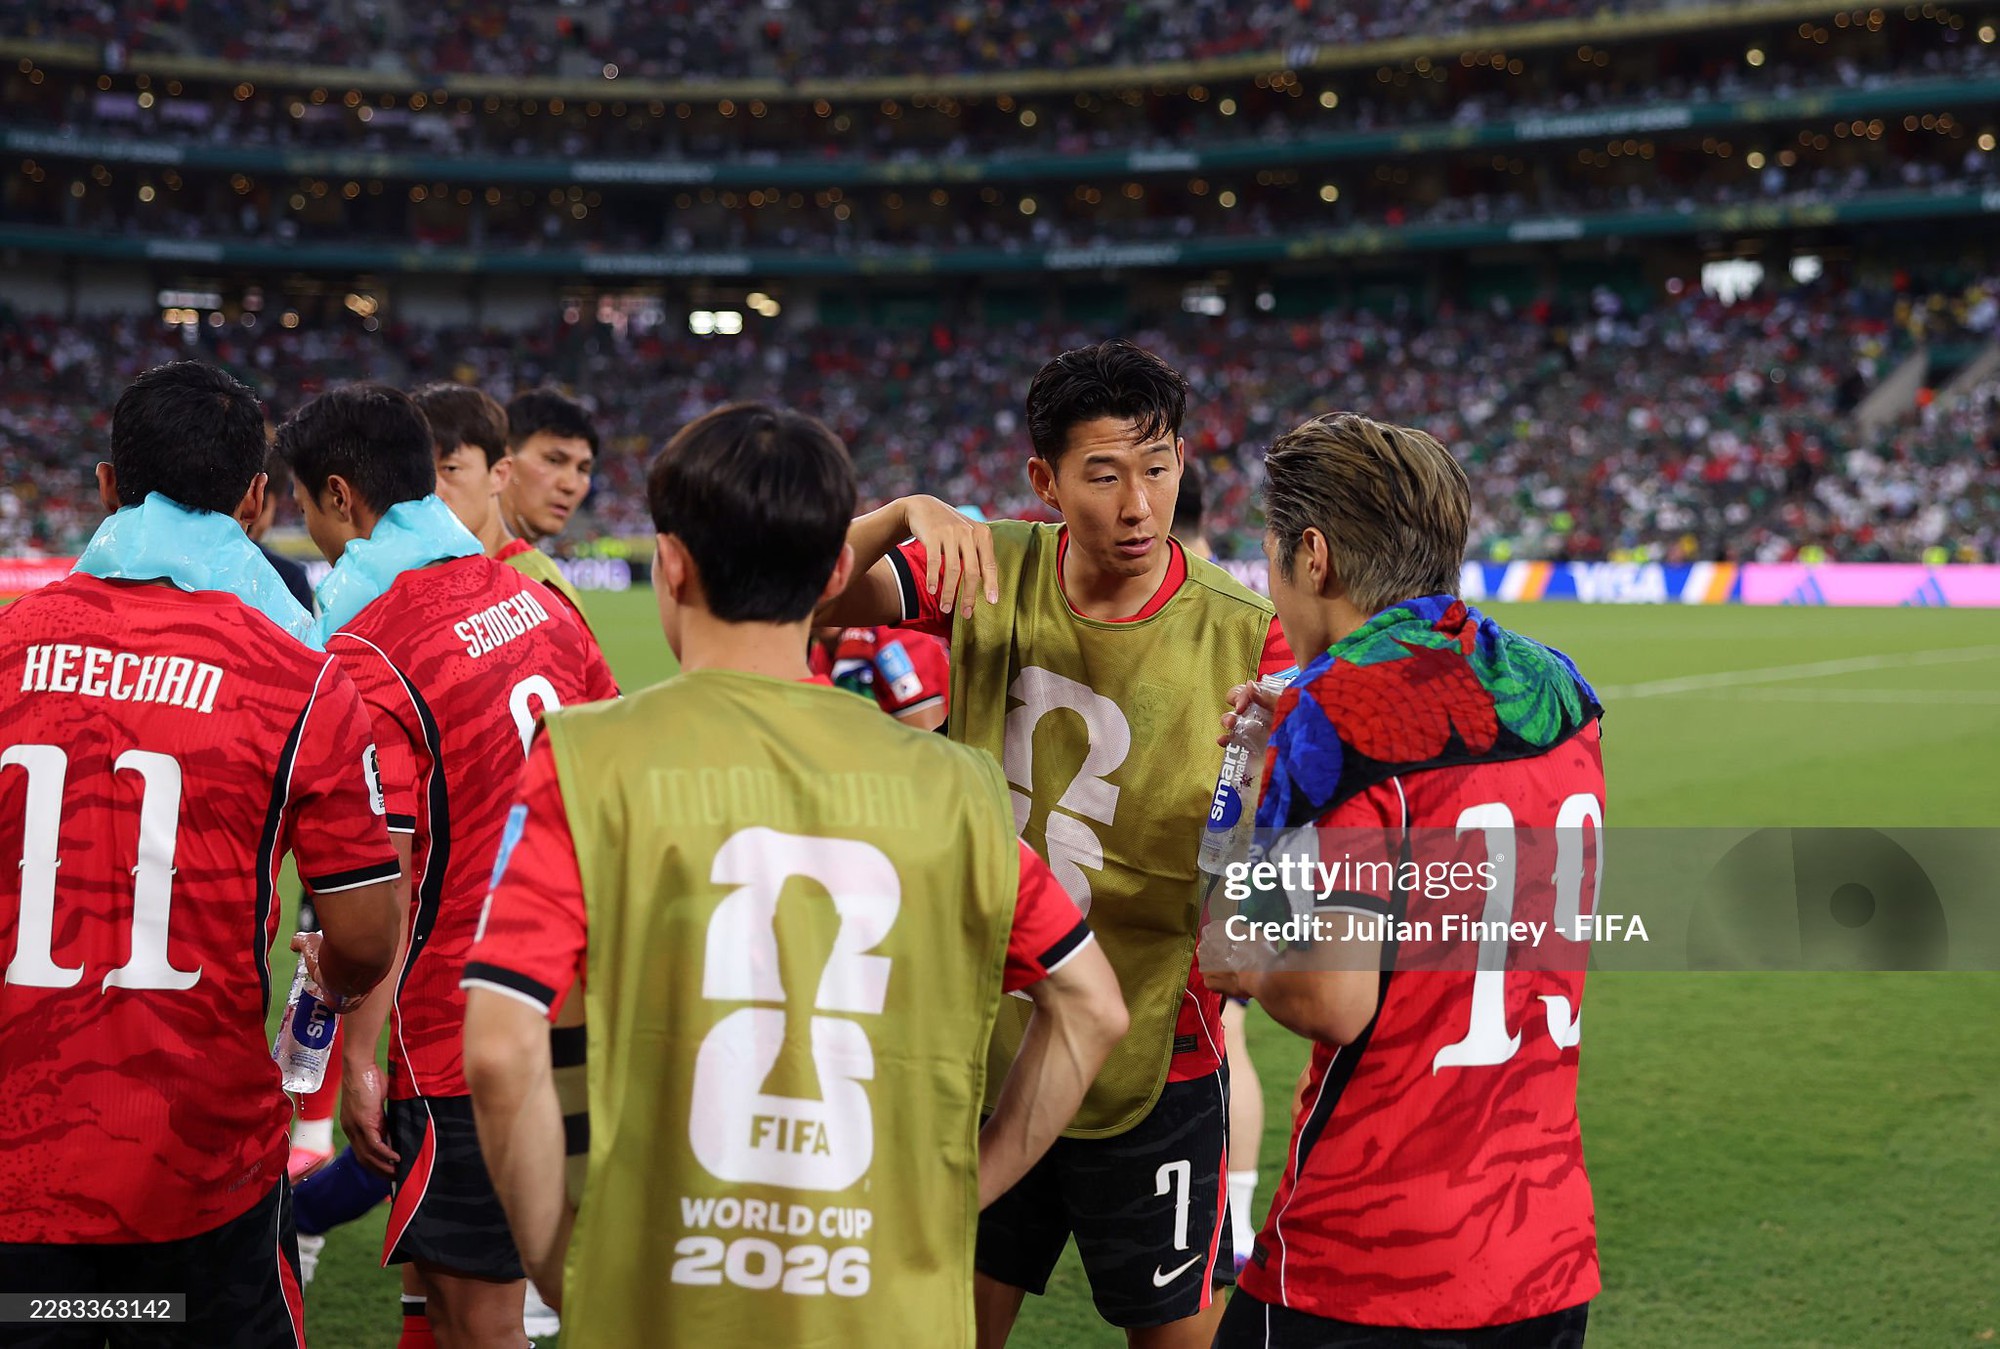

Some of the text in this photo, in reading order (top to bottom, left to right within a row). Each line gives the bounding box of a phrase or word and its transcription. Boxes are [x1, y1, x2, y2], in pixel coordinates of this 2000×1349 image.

[1567, 561, 1669, 603] VISA
[21, 644, 225, 714] HEECHAN
[1210, 743, 1241, 822] smart
[1233, 747, 1250, 785] water
[0, 744, 202, 995] 11
[1432, 793, 1604, 1076] 19
[749, 1115, 831, 1156] FIFA
[681, 1197, 873, 1239] WORLD CUP
[1154, 1159, 1192, 1251] 7
[670, 1236, 871, 1297] 2026
